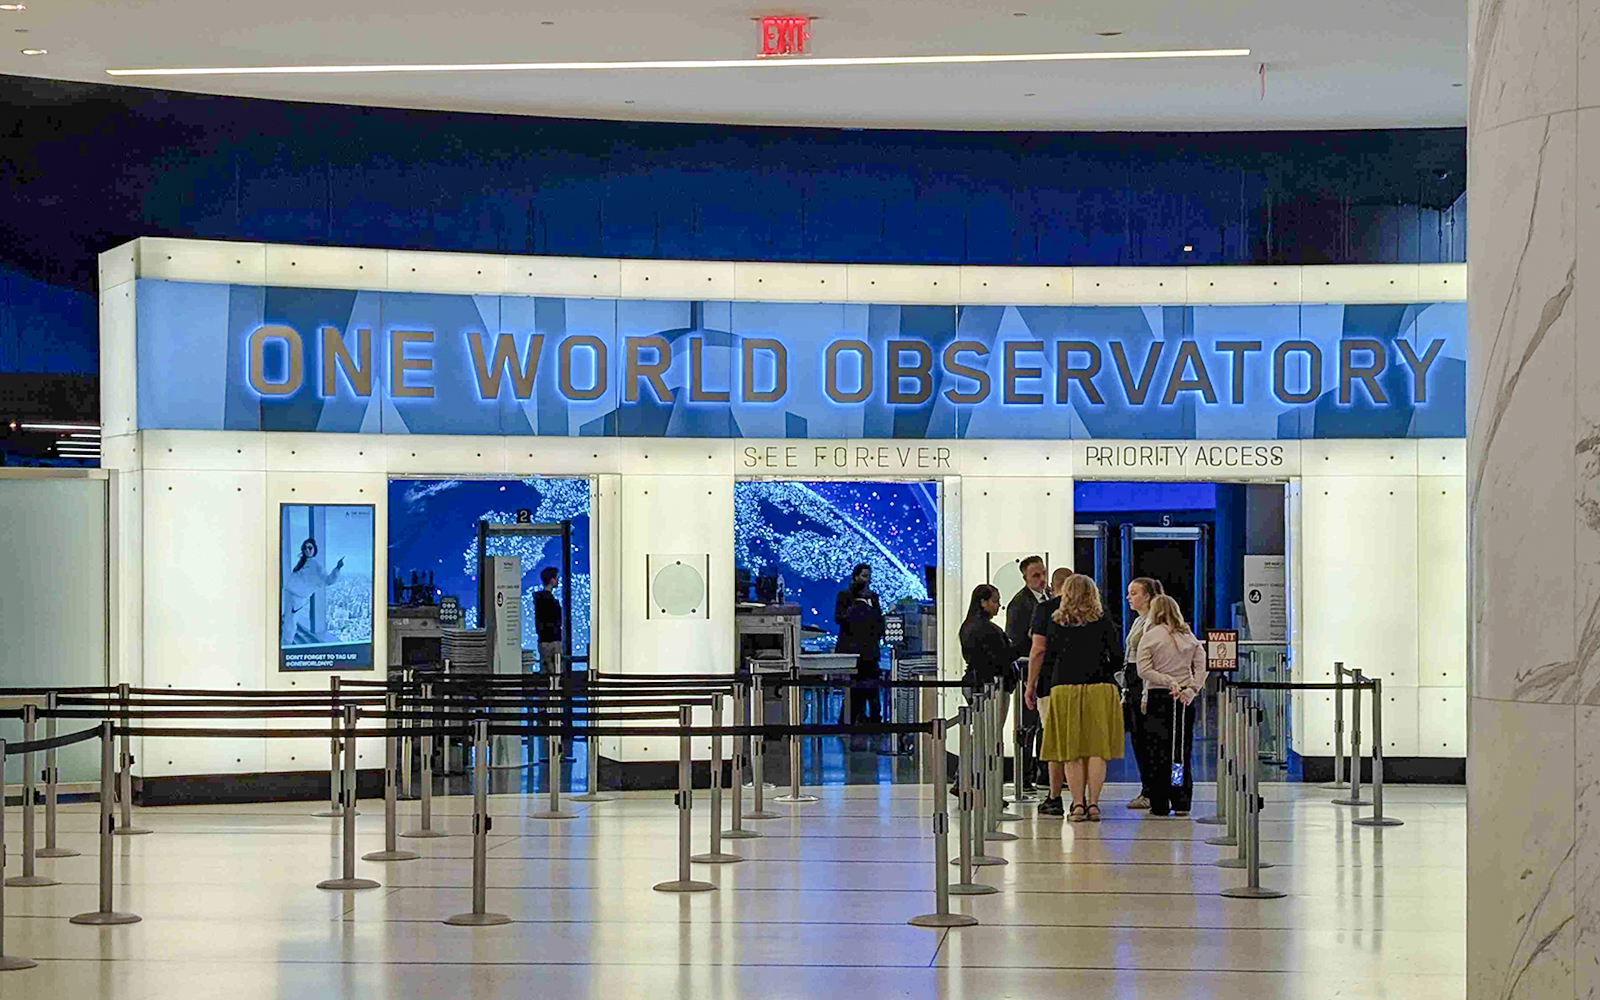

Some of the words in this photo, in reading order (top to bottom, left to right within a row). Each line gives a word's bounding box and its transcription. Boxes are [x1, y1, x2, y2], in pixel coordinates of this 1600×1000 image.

[762, 17, 806, 54] EXIT
[247, 325, 434, 399] ONE
[467, 332, 788, 404] WORLD
[824, 338, 1445, 405] OBSERVATORY
[744, 446, 798, 468] SEE
[814, 446, 951, 468] FOREVER
[1086, 446, 1188, 466] PRIORITY
[1195, 446, 1284, 466] ACCESS
[519, 510, 528, 522] 2
[1162, 515, 1171, 527] 5
[1208, 632, 1236, 641] WAIT
[1209, 659, 1236, 668] HERE
